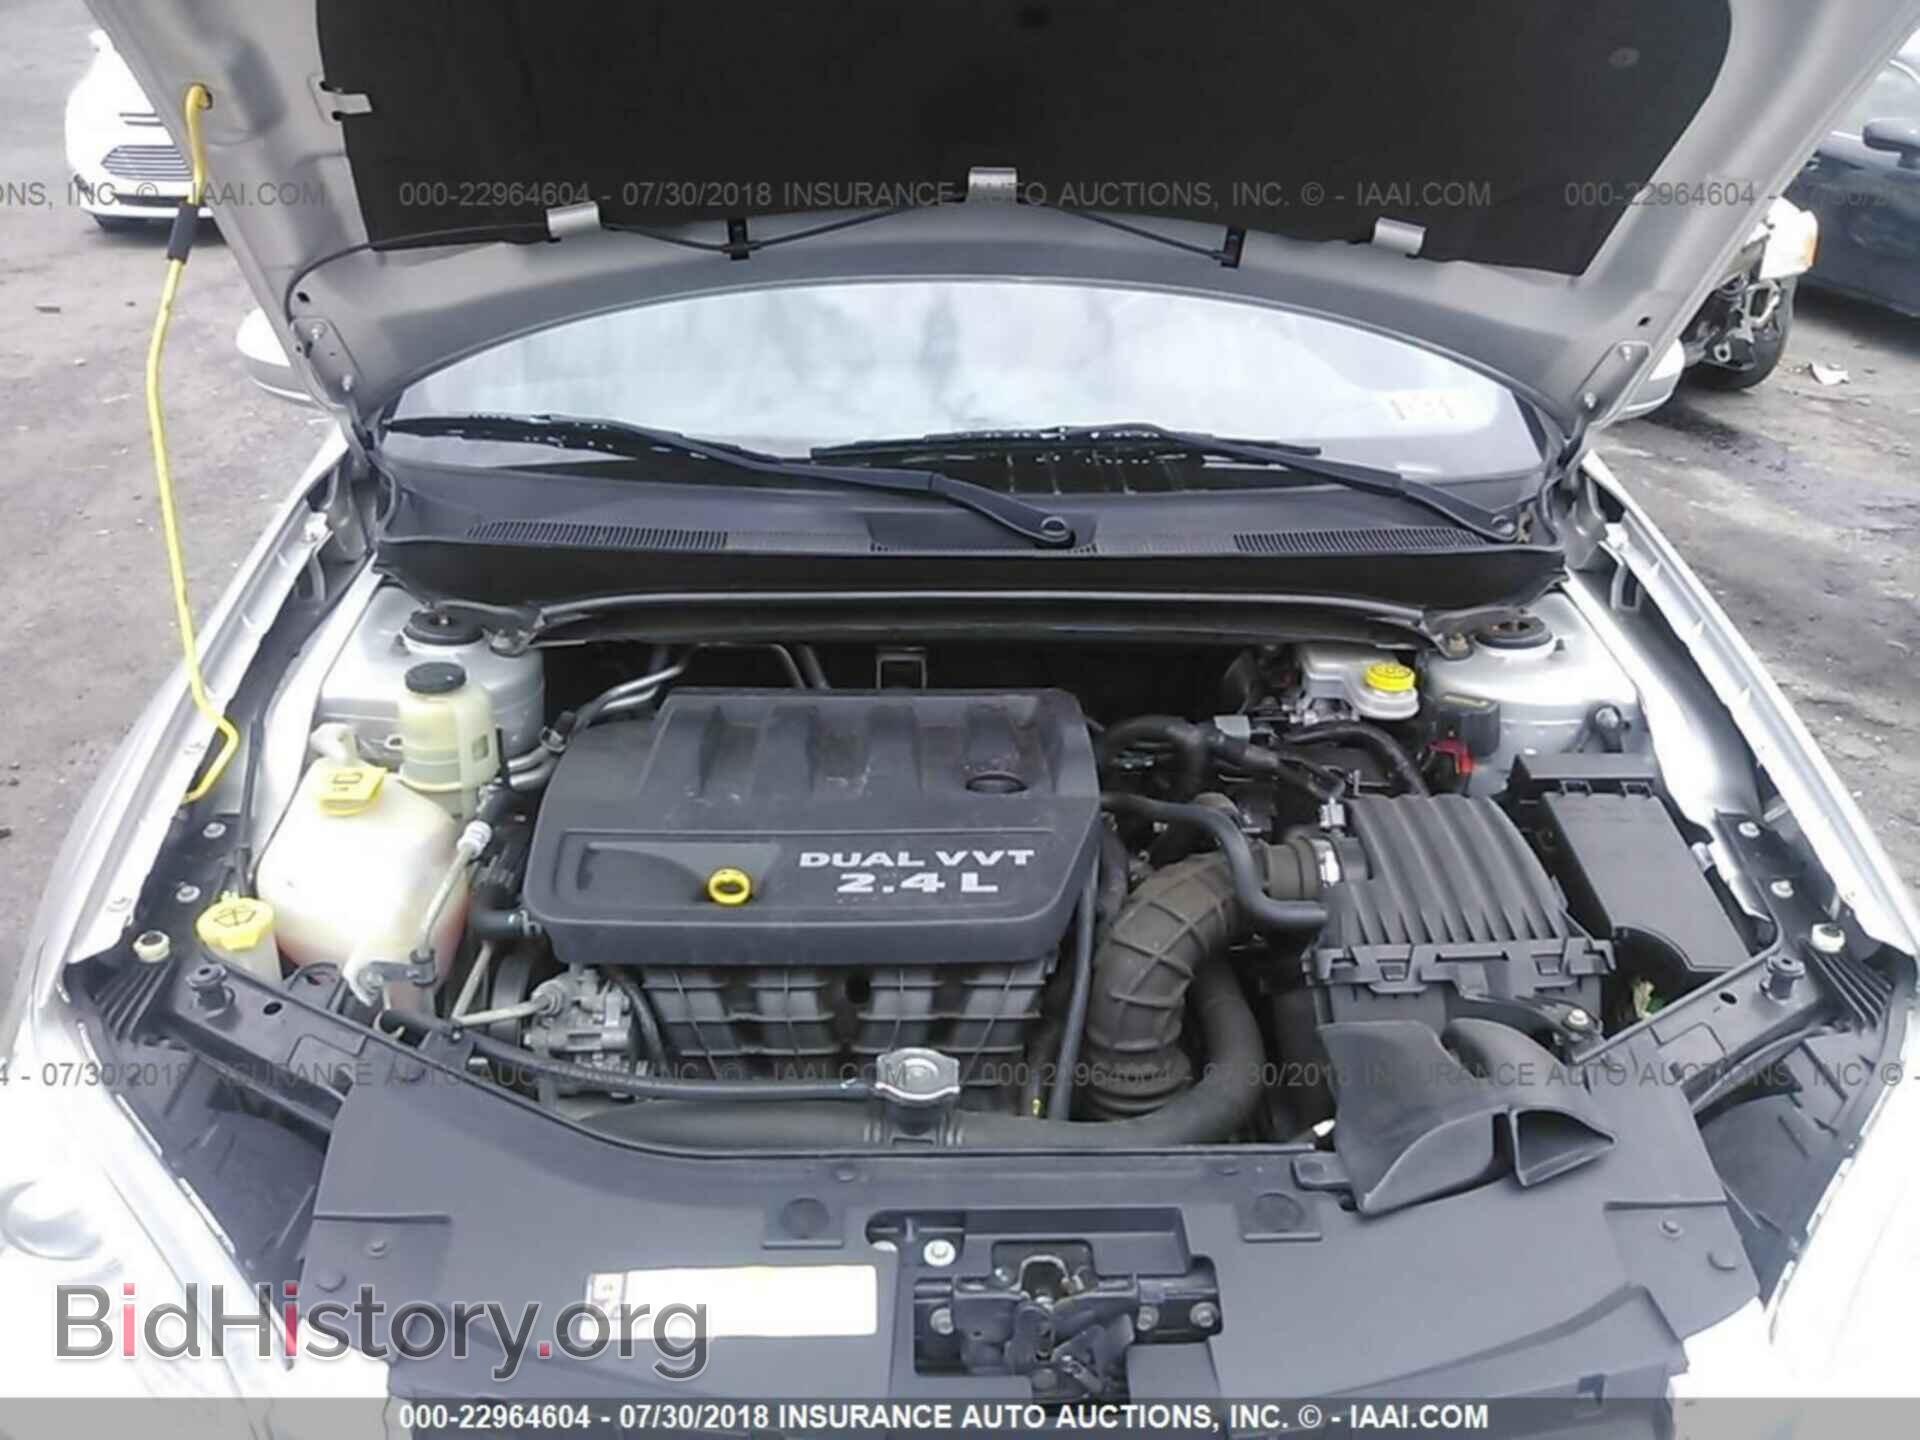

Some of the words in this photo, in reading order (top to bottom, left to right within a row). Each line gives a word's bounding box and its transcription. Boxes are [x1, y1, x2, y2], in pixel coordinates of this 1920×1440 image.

[799, 851, 925, 867] DUAL
[935, 850, 1035, 866] VVT
[837, 872, 946, 893] 2.4
[960, 872, 998, 893] L
